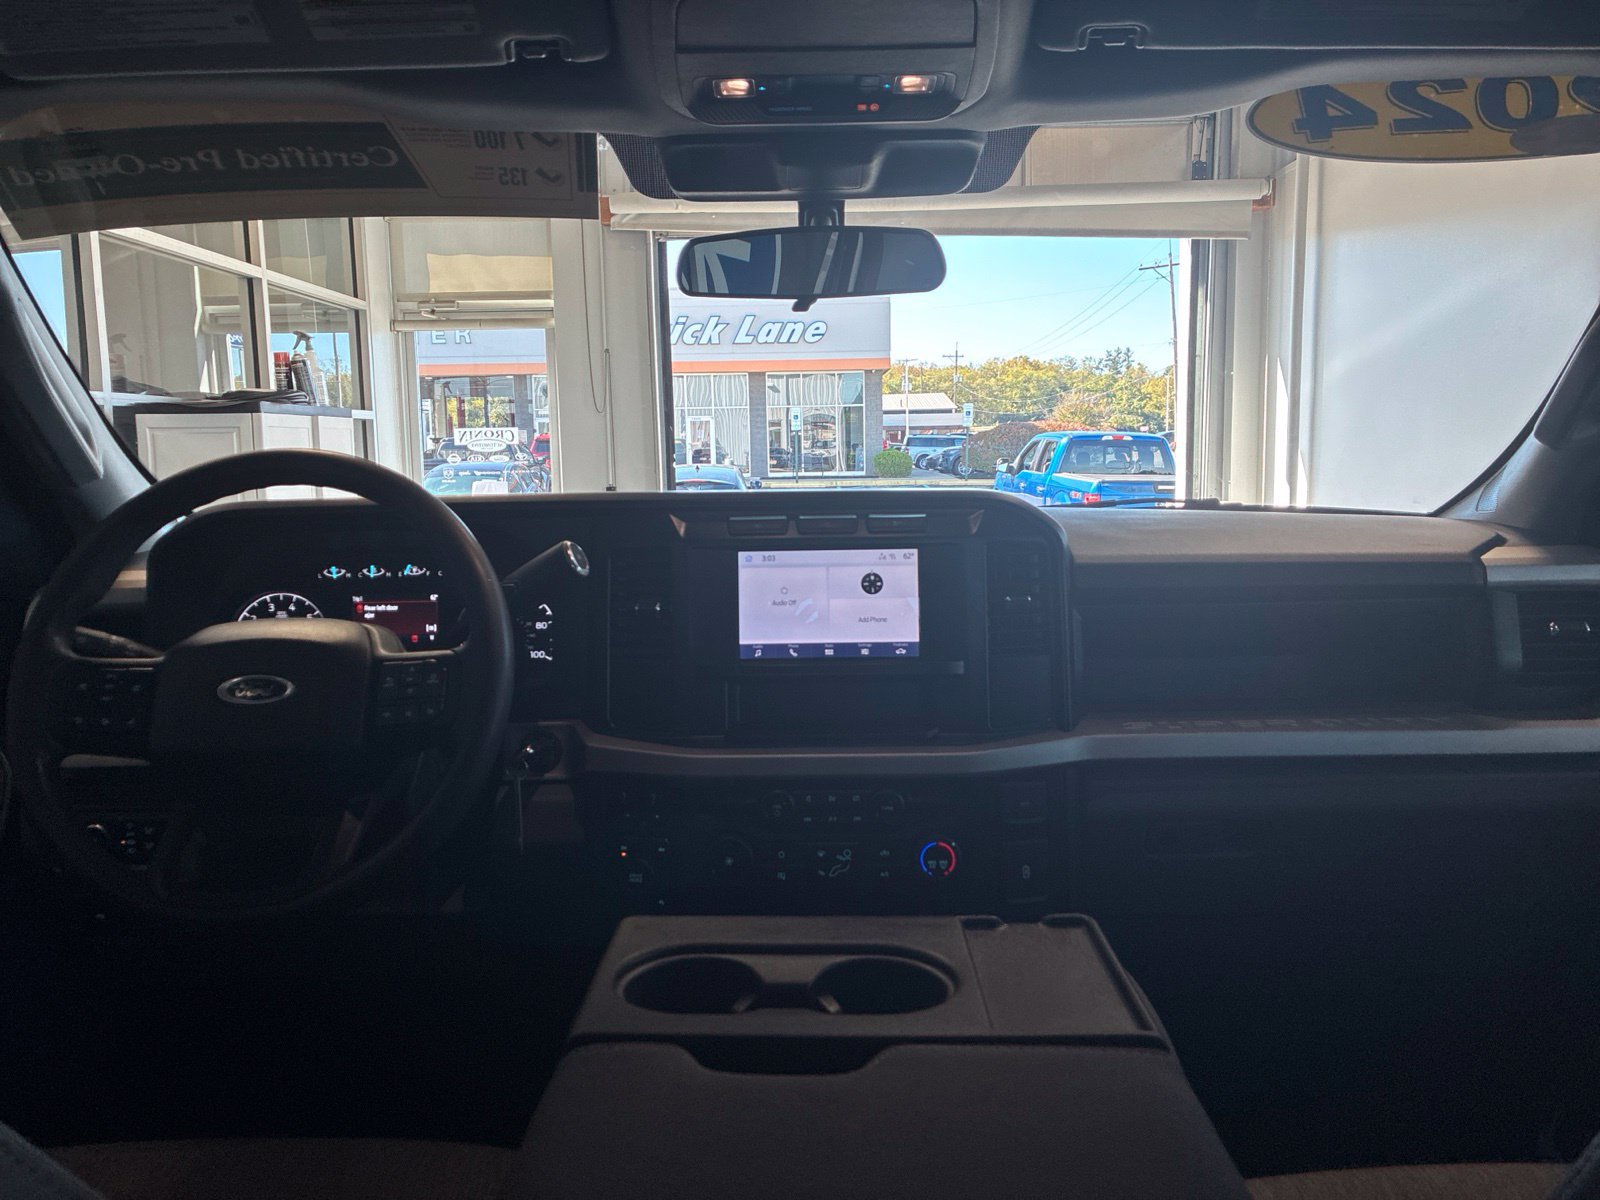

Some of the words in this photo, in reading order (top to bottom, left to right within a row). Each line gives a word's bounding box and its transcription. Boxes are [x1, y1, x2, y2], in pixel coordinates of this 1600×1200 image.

[669, 315, 729, 345] ick
[732, 314, 828, 345] Lane
[417, 329, 472, 345] ER
[267, 603, 275, 612] 3
[288, 603, 296, 612] 4
[535, 621, 548, 630] 80
[530, 650, 546, 659] 100
